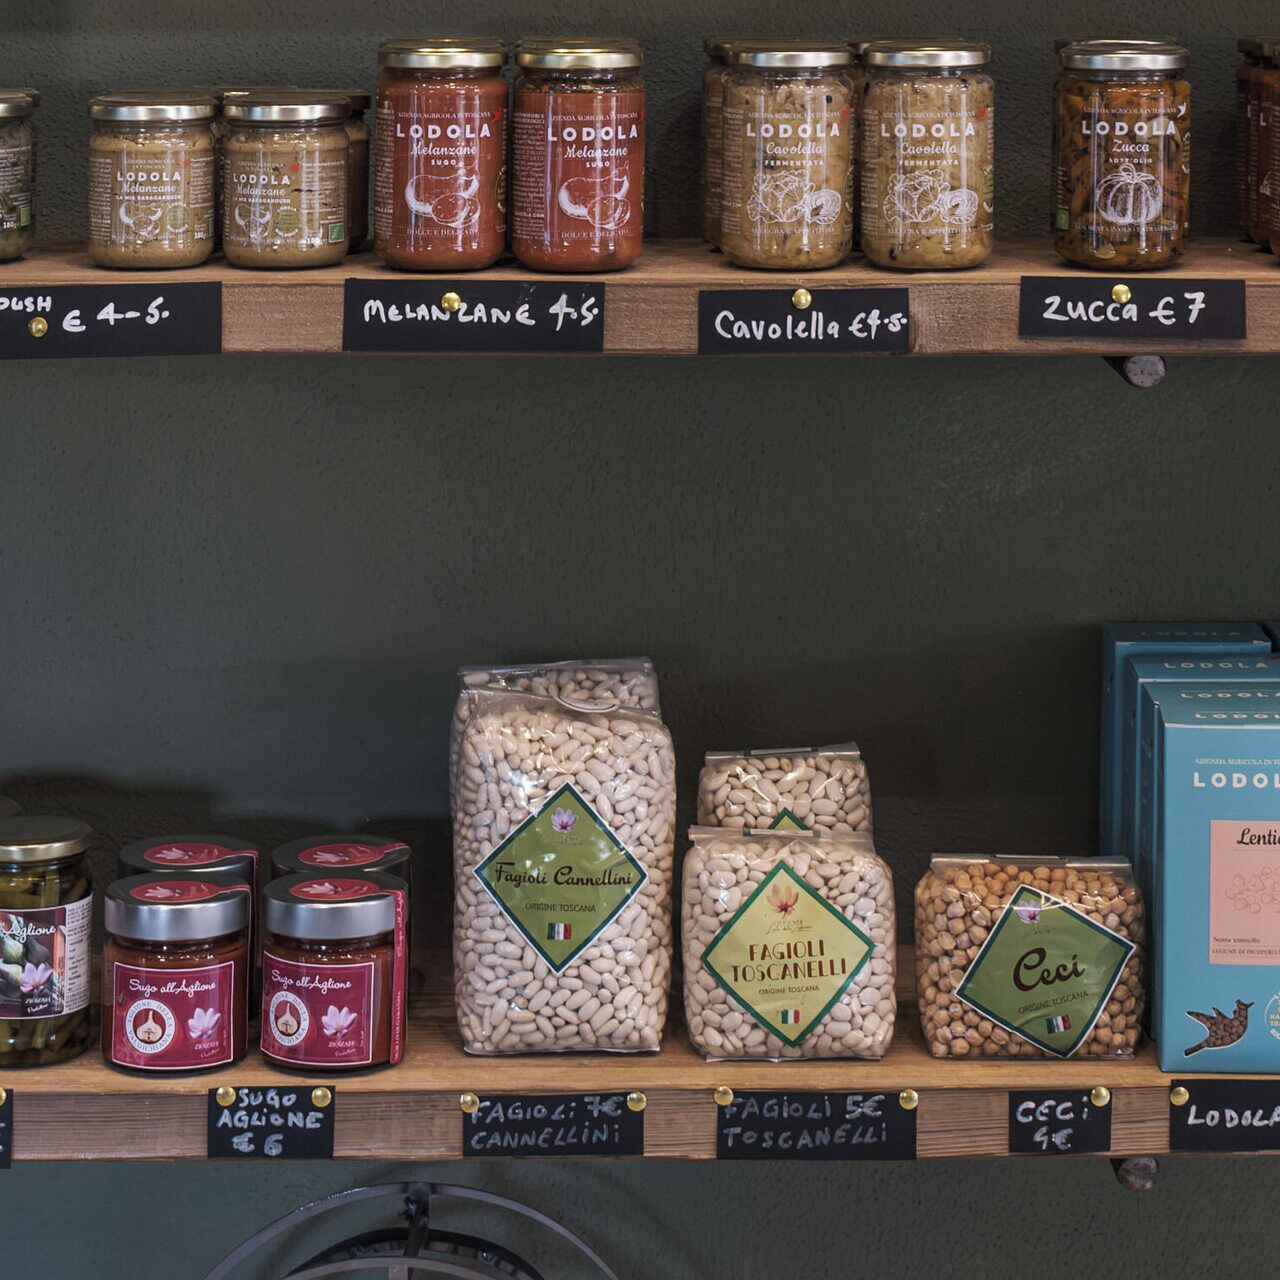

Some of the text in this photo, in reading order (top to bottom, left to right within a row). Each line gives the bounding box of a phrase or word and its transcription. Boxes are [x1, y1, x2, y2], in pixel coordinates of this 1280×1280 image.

[396, 123, 491, 139] LODOLA
[547, 124, 638, 142] LODOLA
[746, 122, 840, 138] LODOLA
[881, 122, 975, 138] LODOLA
[1081, 120, 1176, 136] LODOLA
[410, 141, 478, 156] Melanzane
[564, 145, 628, 159] Melanzane
[765, 141, 823, 156] Cavolella
[900, 141, 958, 156] Cavolella
[1112, 139, 1151, 153] Zucca
[117, 171, 182, 182] LODOLA
[233, 173, 290, 185] LODOLA
[714, 309, 839, 340] Cavolella
[495, 861, 632, 888] Fagioli Cannellini
[559, 904, 596, 913] TOSCANA
[749, 939, 825, 962] FAGIOLI
[732, 958, 847, 983] TOSCANELLI
[1013, 947, 1086, 992] Ceci
[128, 979, 157, 997] Sugo
[239, 1087, 297, 1109] SUGO
